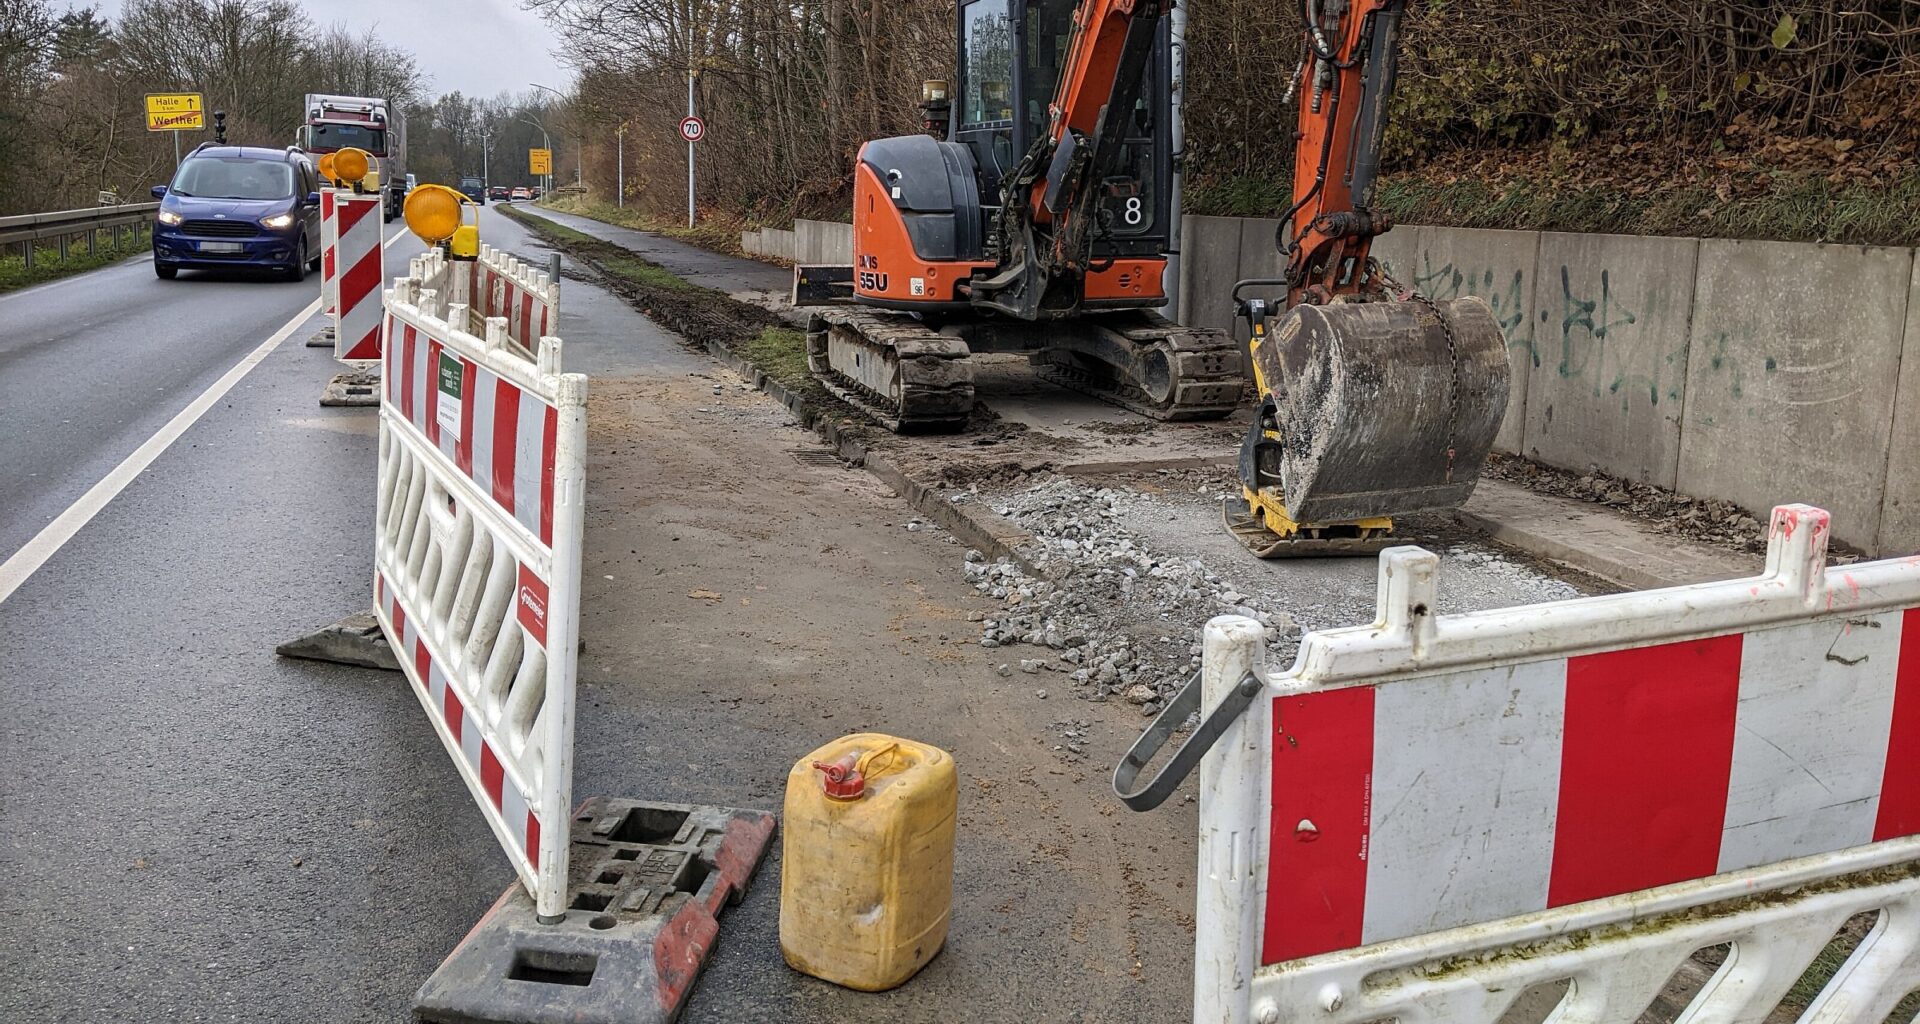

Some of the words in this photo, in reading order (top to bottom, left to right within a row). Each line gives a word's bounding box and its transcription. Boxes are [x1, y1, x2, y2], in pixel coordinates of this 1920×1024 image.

[155, 98, 179, 106] Halle
[153, 115, 198, 125] Werther
[685, 123, 699, 135] 70
[1125, 197, 1141, 225] 8
[860, 271, 889, 292] 55U
[914, 285, 923, 295] 96
[1358, 834, 1368, 861] nissen
